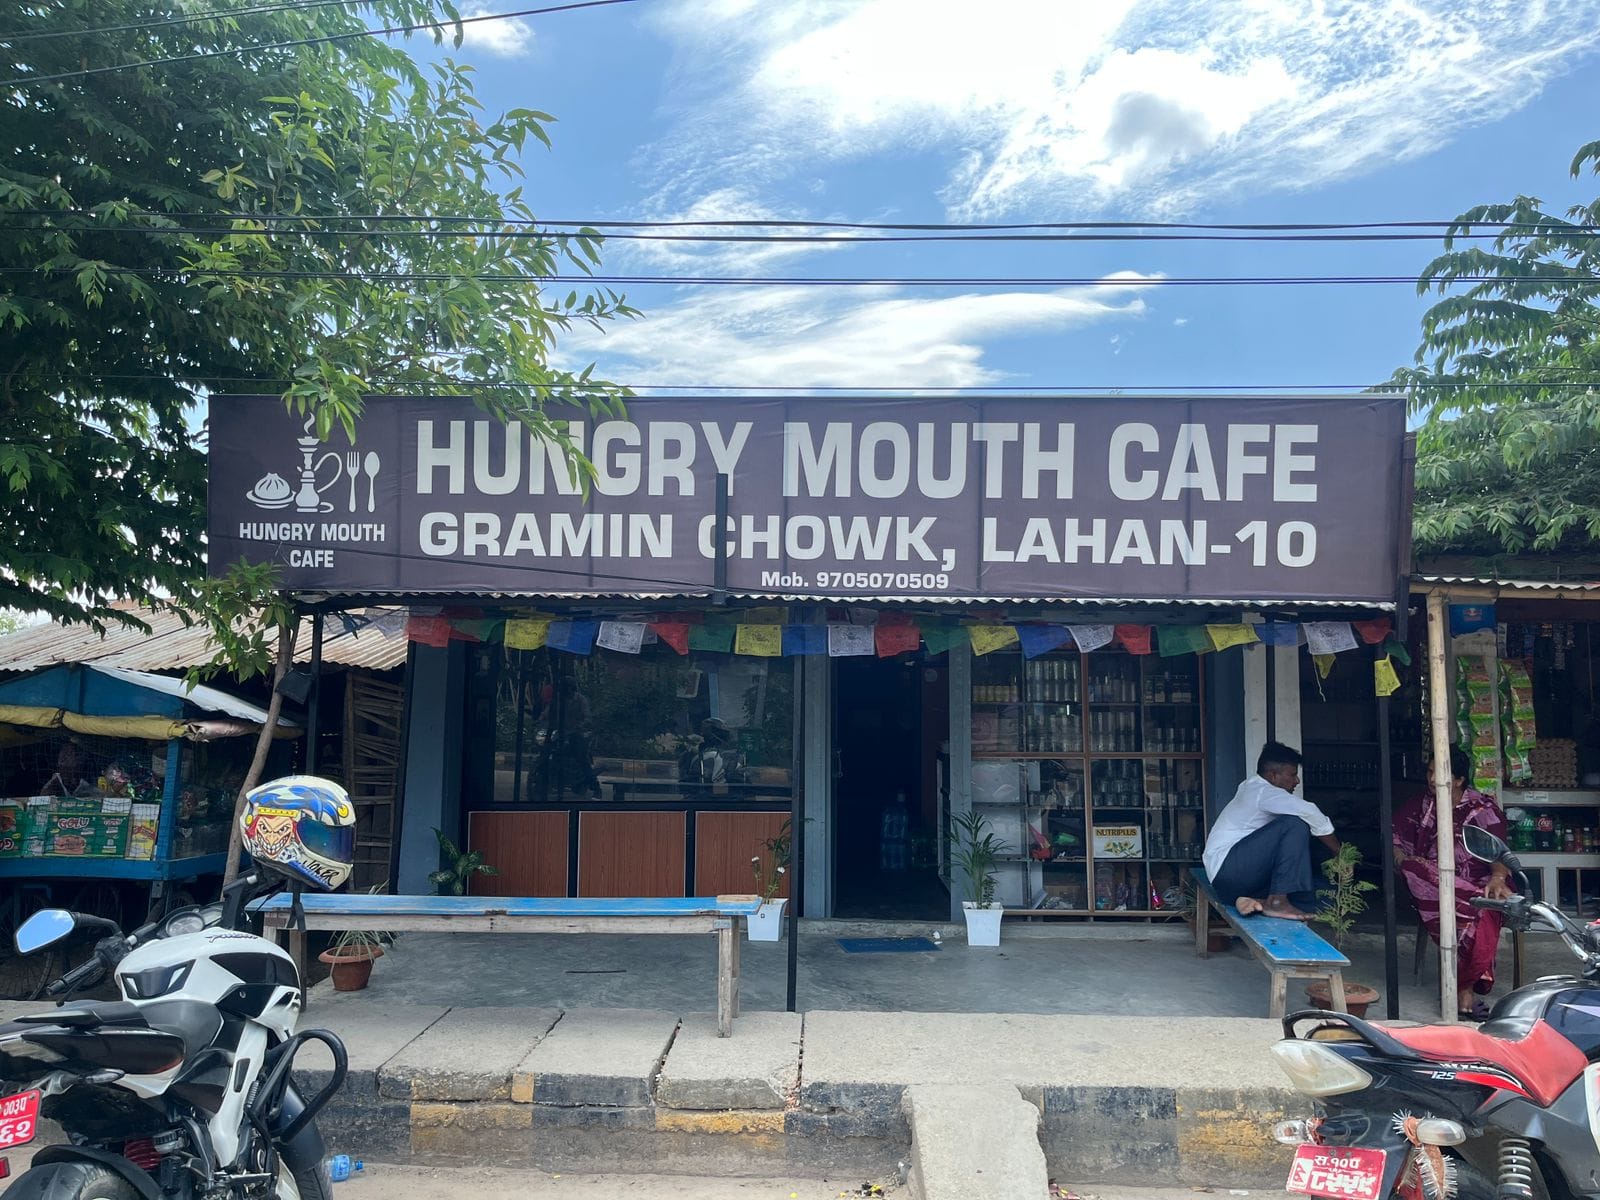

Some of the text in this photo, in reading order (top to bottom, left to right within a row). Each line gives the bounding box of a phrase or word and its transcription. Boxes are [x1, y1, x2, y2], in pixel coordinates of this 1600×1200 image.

[416, 420, 1320, 504] HUNGRY MOUTH CAFE
[238, 522, 386, 543] HUNGRY MOUTH
[419, 511, 1318, 573] GRAMIN CHOWK, LAHAN-10
[289, 549, 335, 569] CAFE
[760, 570, 949, 591] Mob. 9705070509
[1431, 1071, 1456, 1080] 125
